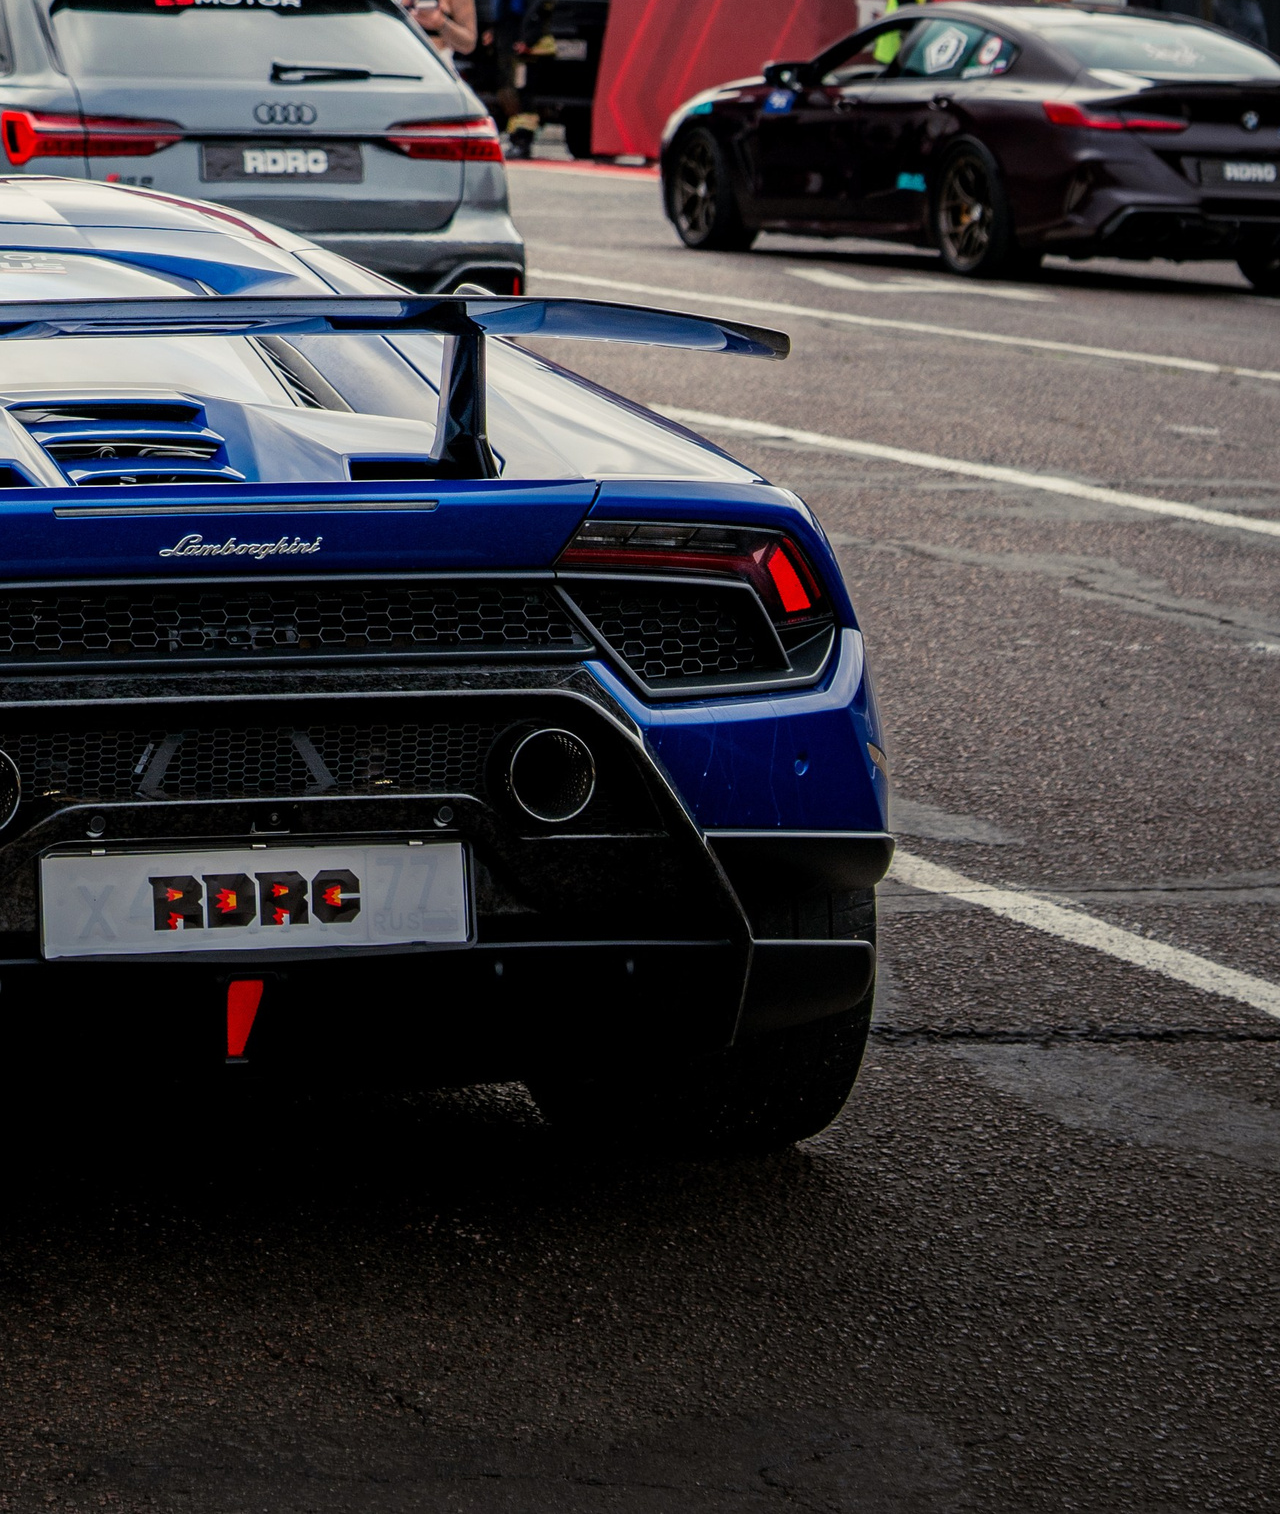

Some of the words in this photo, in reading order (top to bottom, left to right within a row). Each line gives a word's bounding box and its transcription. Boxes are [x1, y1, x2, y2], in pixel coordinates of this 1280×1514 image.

[242, 148, 329, 174] RDRC
[158, 533, 324, 560] Lamborghini
[148, 868, 361, 931] RDRC
